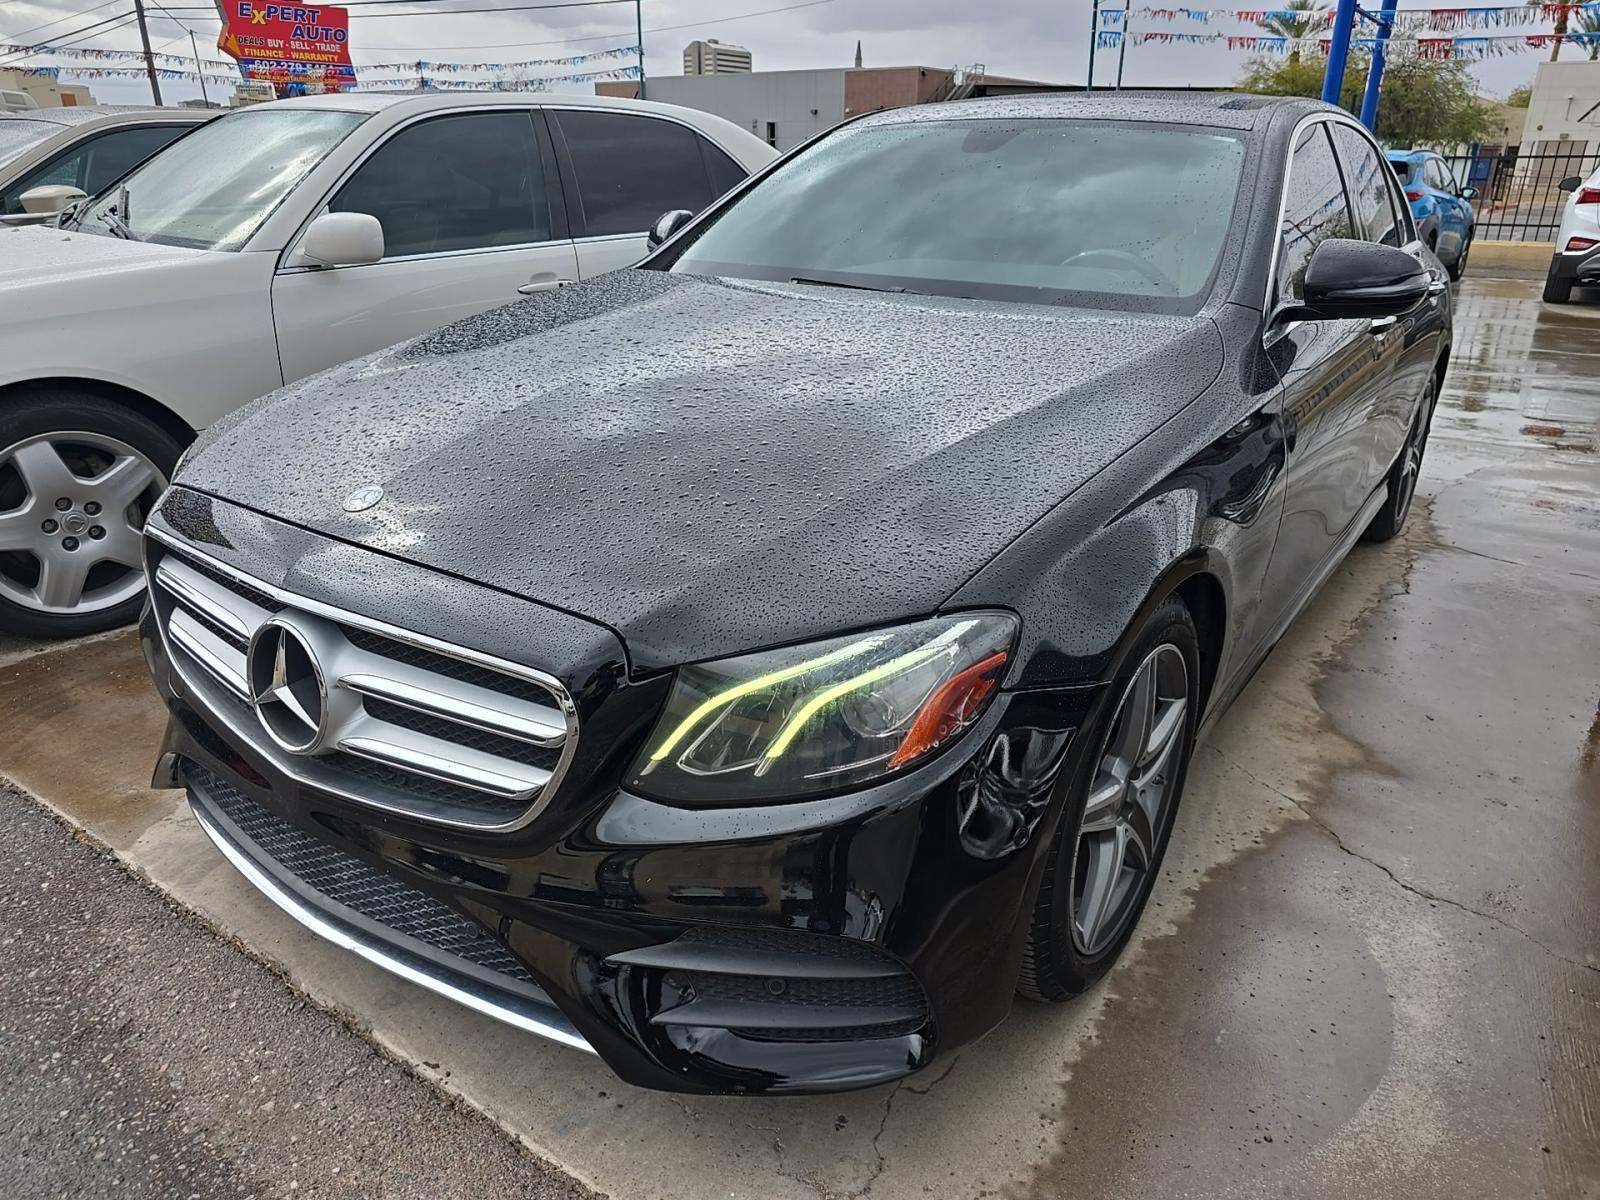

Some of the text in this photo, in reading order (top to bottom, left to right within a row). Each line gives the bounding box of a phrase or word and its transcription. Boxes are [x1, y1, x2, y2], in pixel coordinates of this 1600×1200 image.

[238, 2, 320, 24] EXPERT
[238, 35, 264, 45] DEALS
[290, 25, 347, 43] AUTO
[267, 38, 283, 48] BUY
[290, 41, 310, 50] SELL
[315, 42, 341, 52] TRADE
[244, 48, 284, 59] FINANCE
[290, 51, 339, 62] WARRANTY
